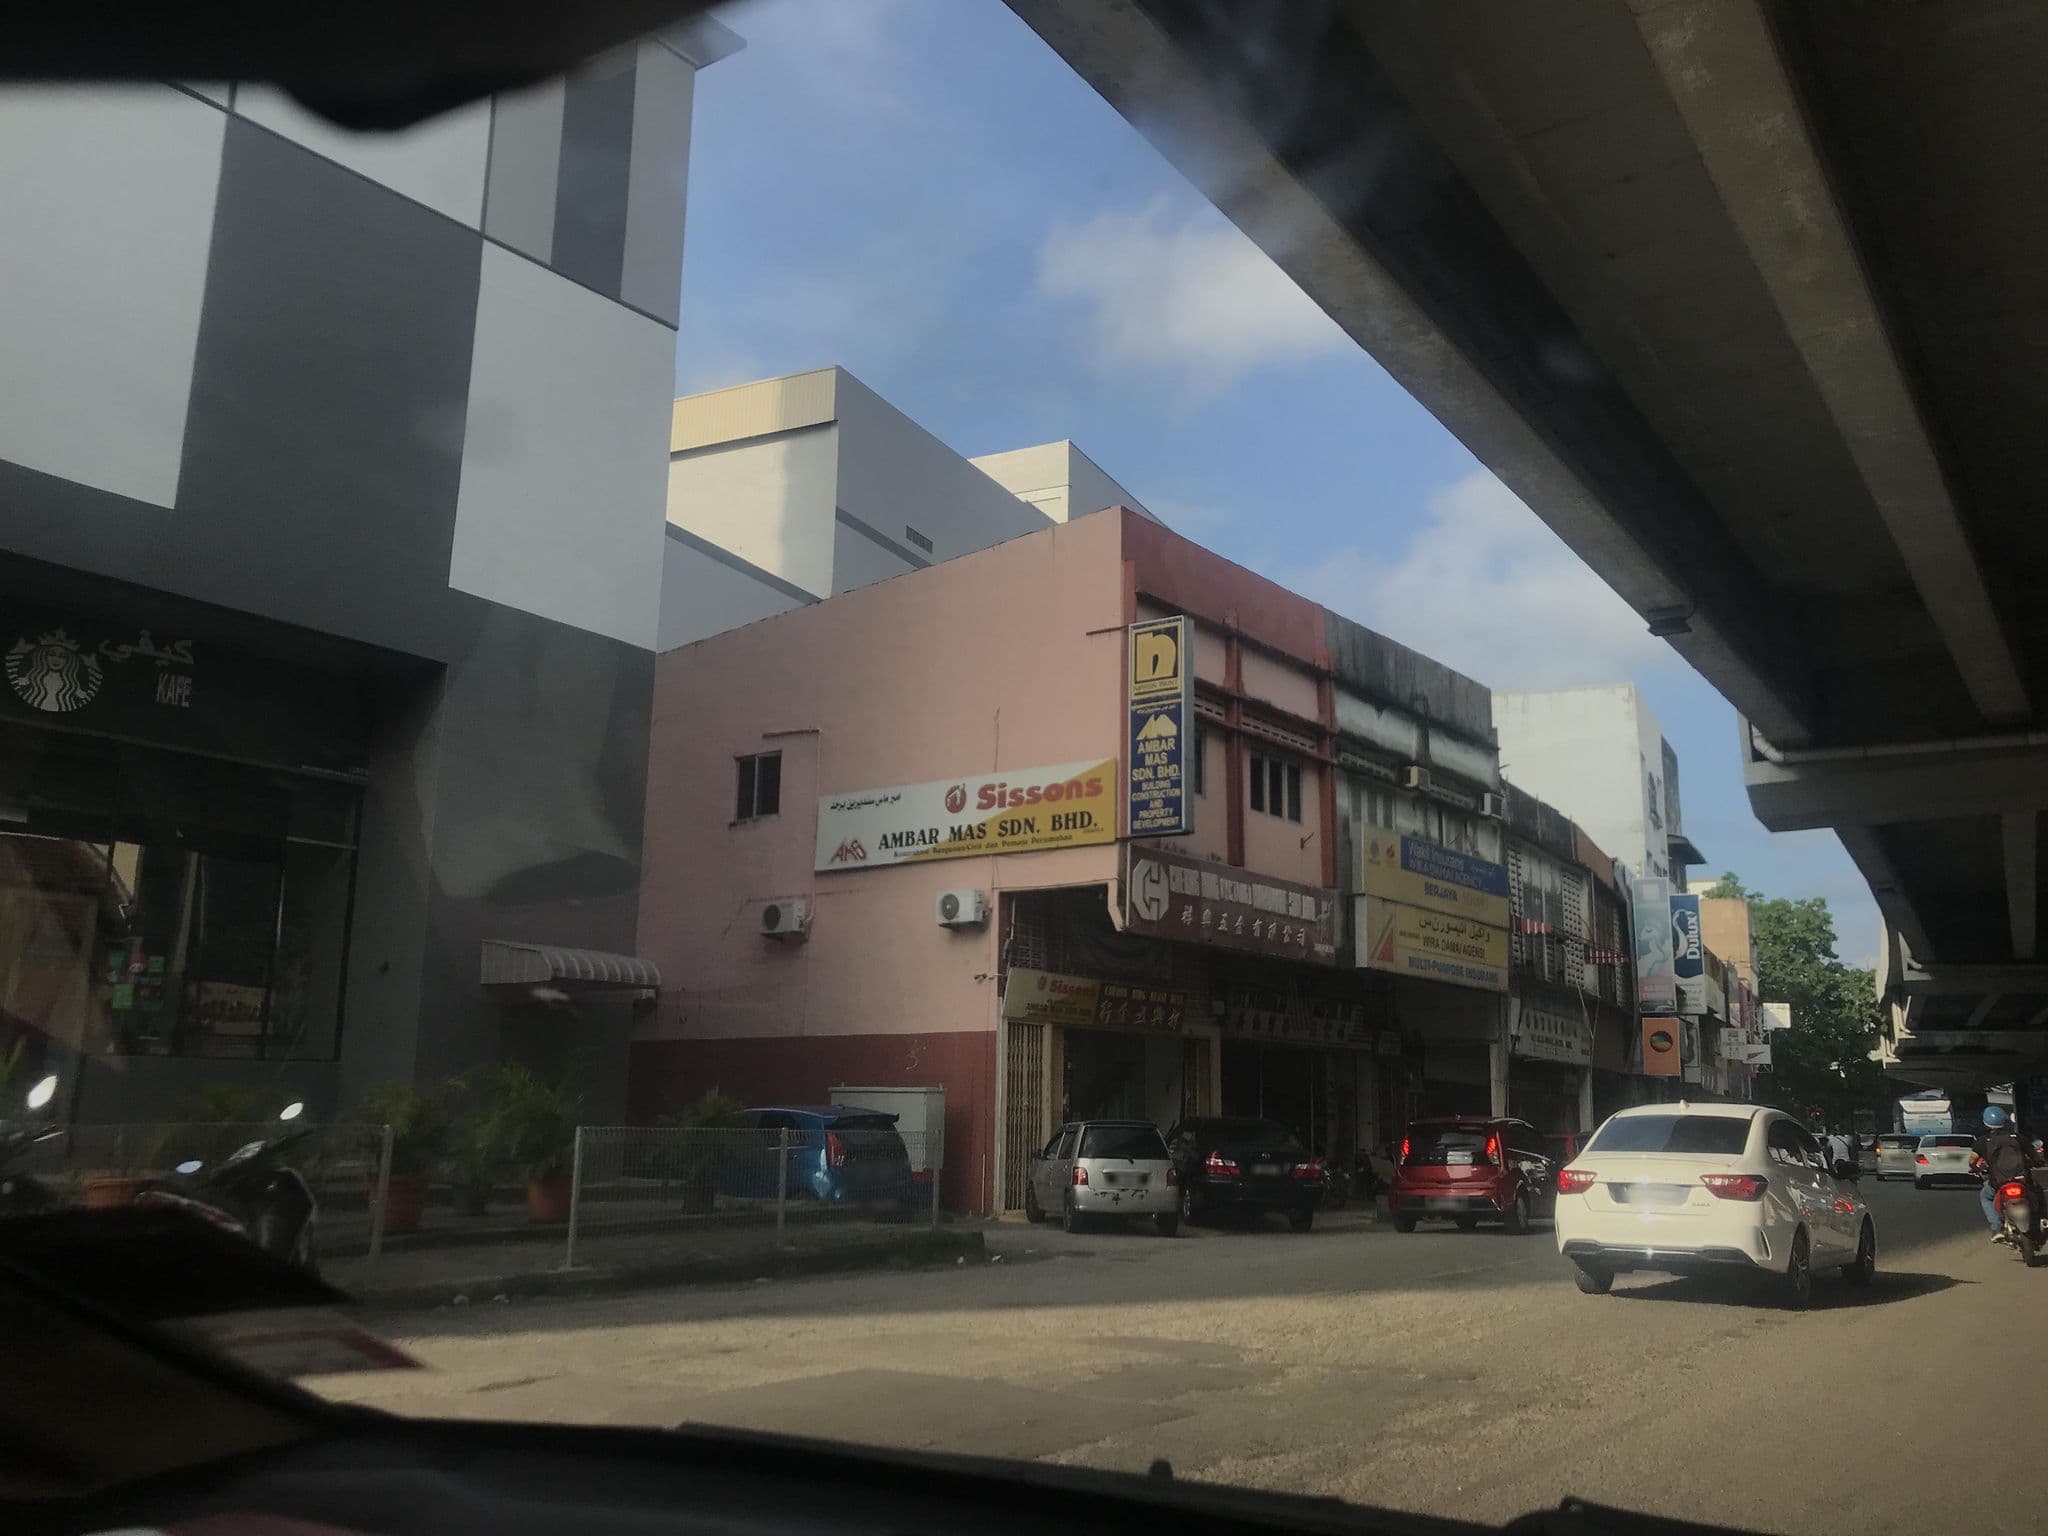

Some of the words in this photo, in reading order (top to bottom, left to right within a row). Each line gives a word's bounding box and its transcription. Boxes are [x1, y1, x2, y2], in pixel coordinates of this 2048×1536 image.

[155, 671, 193, 708] KAFE
[1137, 738, 1176, 754] AMBAR
[1144, 752, 1168, 766] MAS
[1132, 767, 1156, 781] SDN.
[1158, 764, 1180, 778] BHD.
[976, 776, 1104, 811] Sissons
[1132, 788, 1181, 801] CONSTRUCTION
[1139, 807, 1174, 818] PROPERTY
[878, 828, 940, 851] AMBAR
[948, 821, 987, 843] MAS
[997, 815, 1041, 837] SDN.
[1050, 810, 1098, 831] BHD.
[1132, 816, 1180, 830] DEVELOPMENT
[1423, 936, 1440, 949] WIRA
[1686, 911, 1701, 960] Dulux
